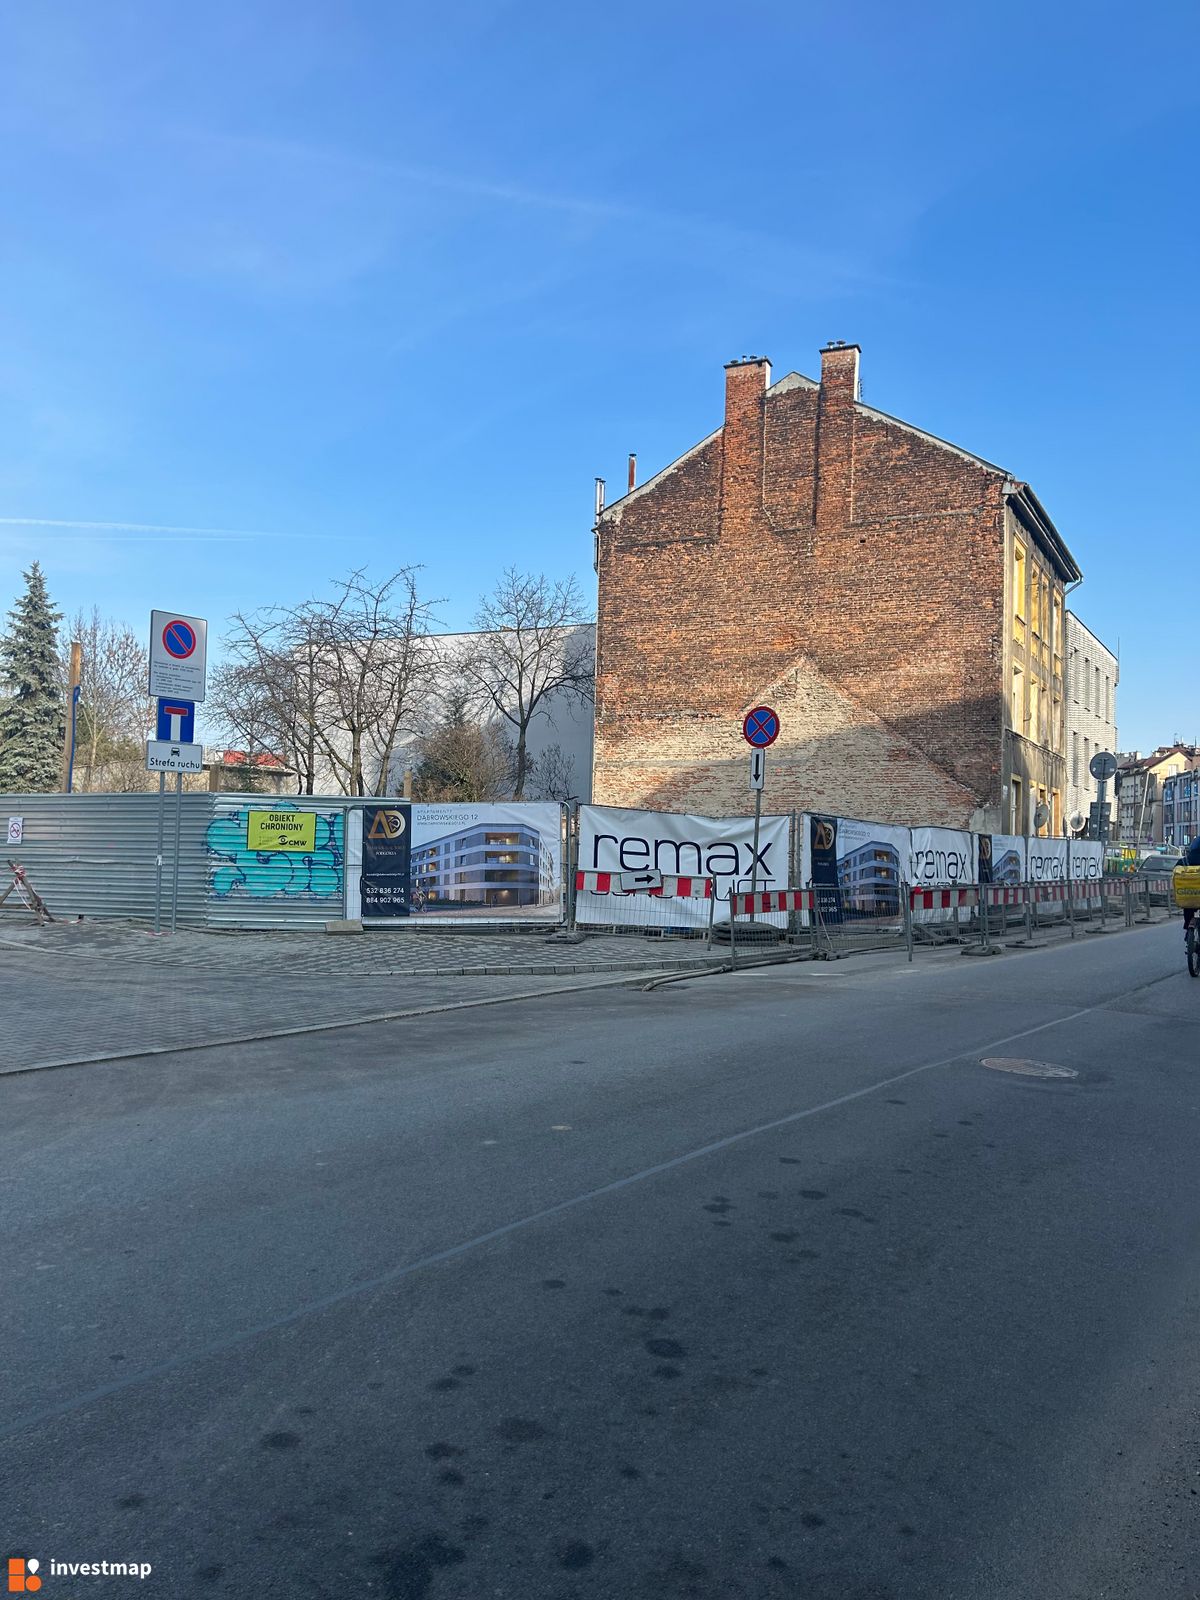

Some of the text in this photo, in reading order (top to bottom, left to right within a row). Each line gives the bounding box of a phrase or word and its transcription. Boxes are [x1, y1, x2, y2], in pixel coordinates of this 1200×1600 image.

[150, 757, 200, 769] Strefa ruchu
[269, 814, 296, 822] OBIEKT
[260, 822, 304, 831] CHRONIONY
[593, 833, 773, 876] remax
[914, 849, 967, 880] remax
[1031, 856, 1065, 879] remax
[1073, 856, 1101, 877] remax
[366, 896, 405, 904] 884 902 965
